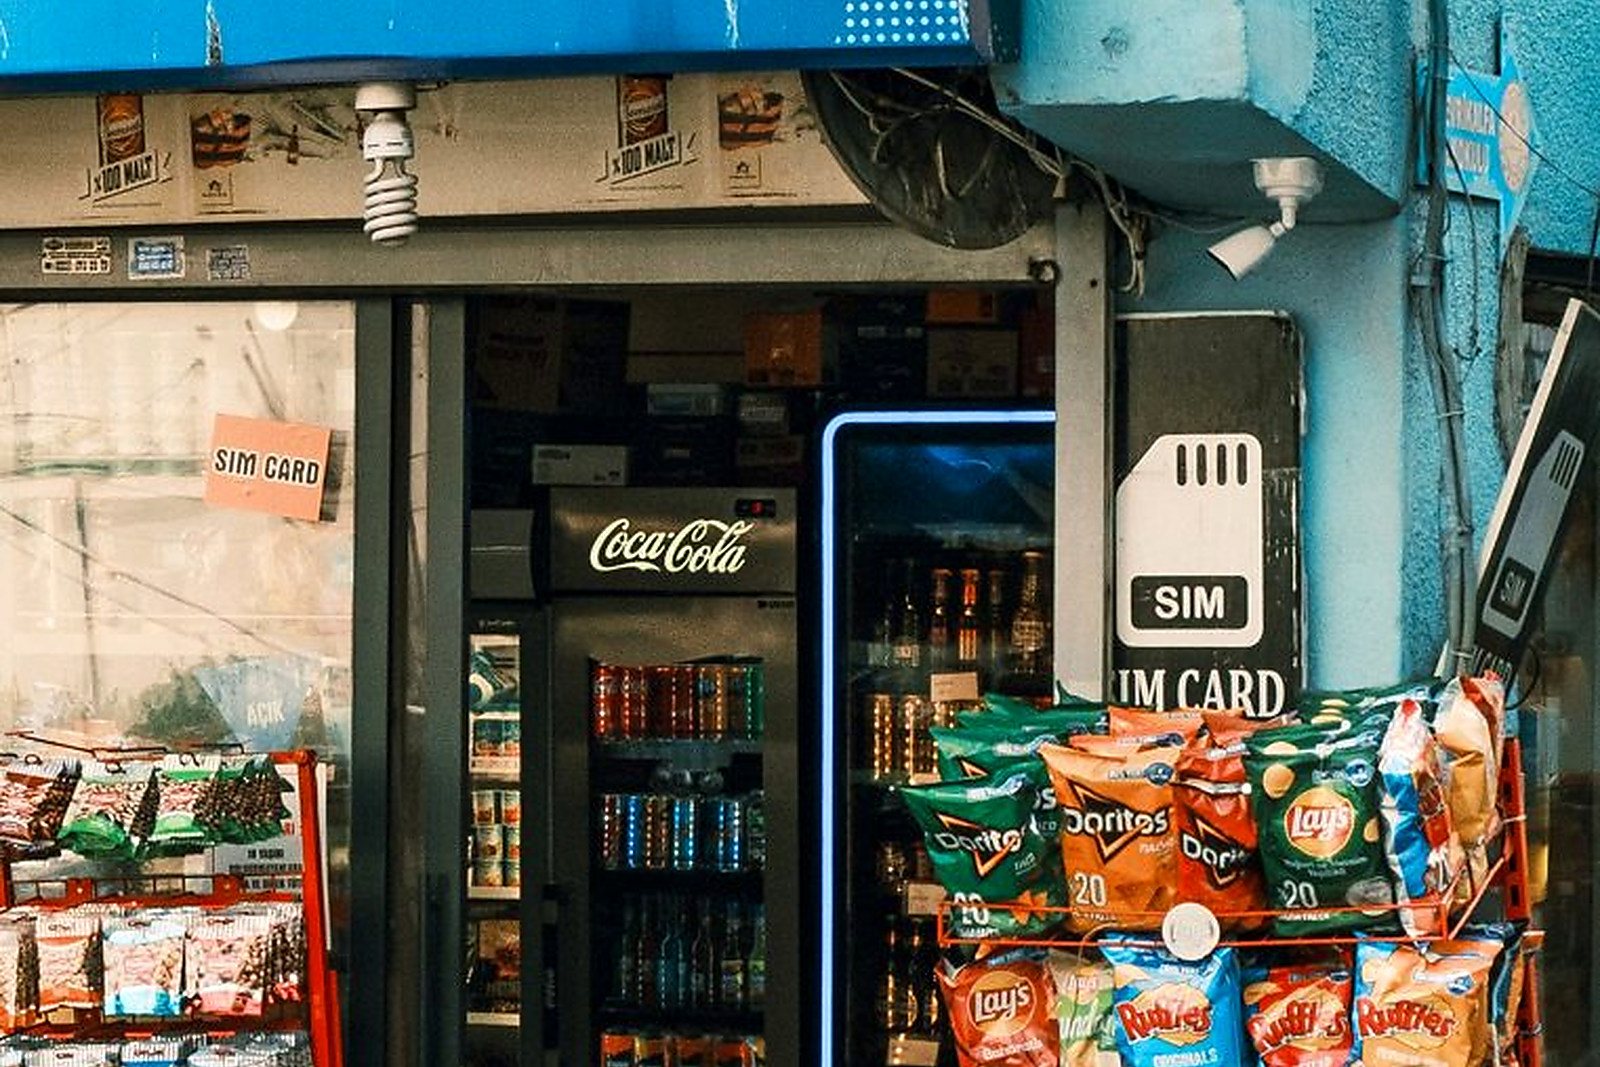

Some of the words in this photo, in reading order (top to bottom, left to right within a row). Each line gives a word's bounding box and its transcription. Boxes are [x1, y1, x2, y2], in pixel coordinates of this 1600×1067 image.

[215, 449, 257, 476] SIM
[265, 456, 320, 485] CARD
[590, 518, 755, 573] Coca-Cola
[1154, 585, 1225, 619] SIM
[1111, 668, 1167, 713] IM
[1177, 668, 1286, 718] CARD
[1063, 807, 1168, 835] Doritos
[1074, 871, 1107, 907] 20
[1283, 880, 1319, 908] 20
[975, 982, 1031, 1023] Lay's
[1357, 998, 1457, 1037] Ruffles
